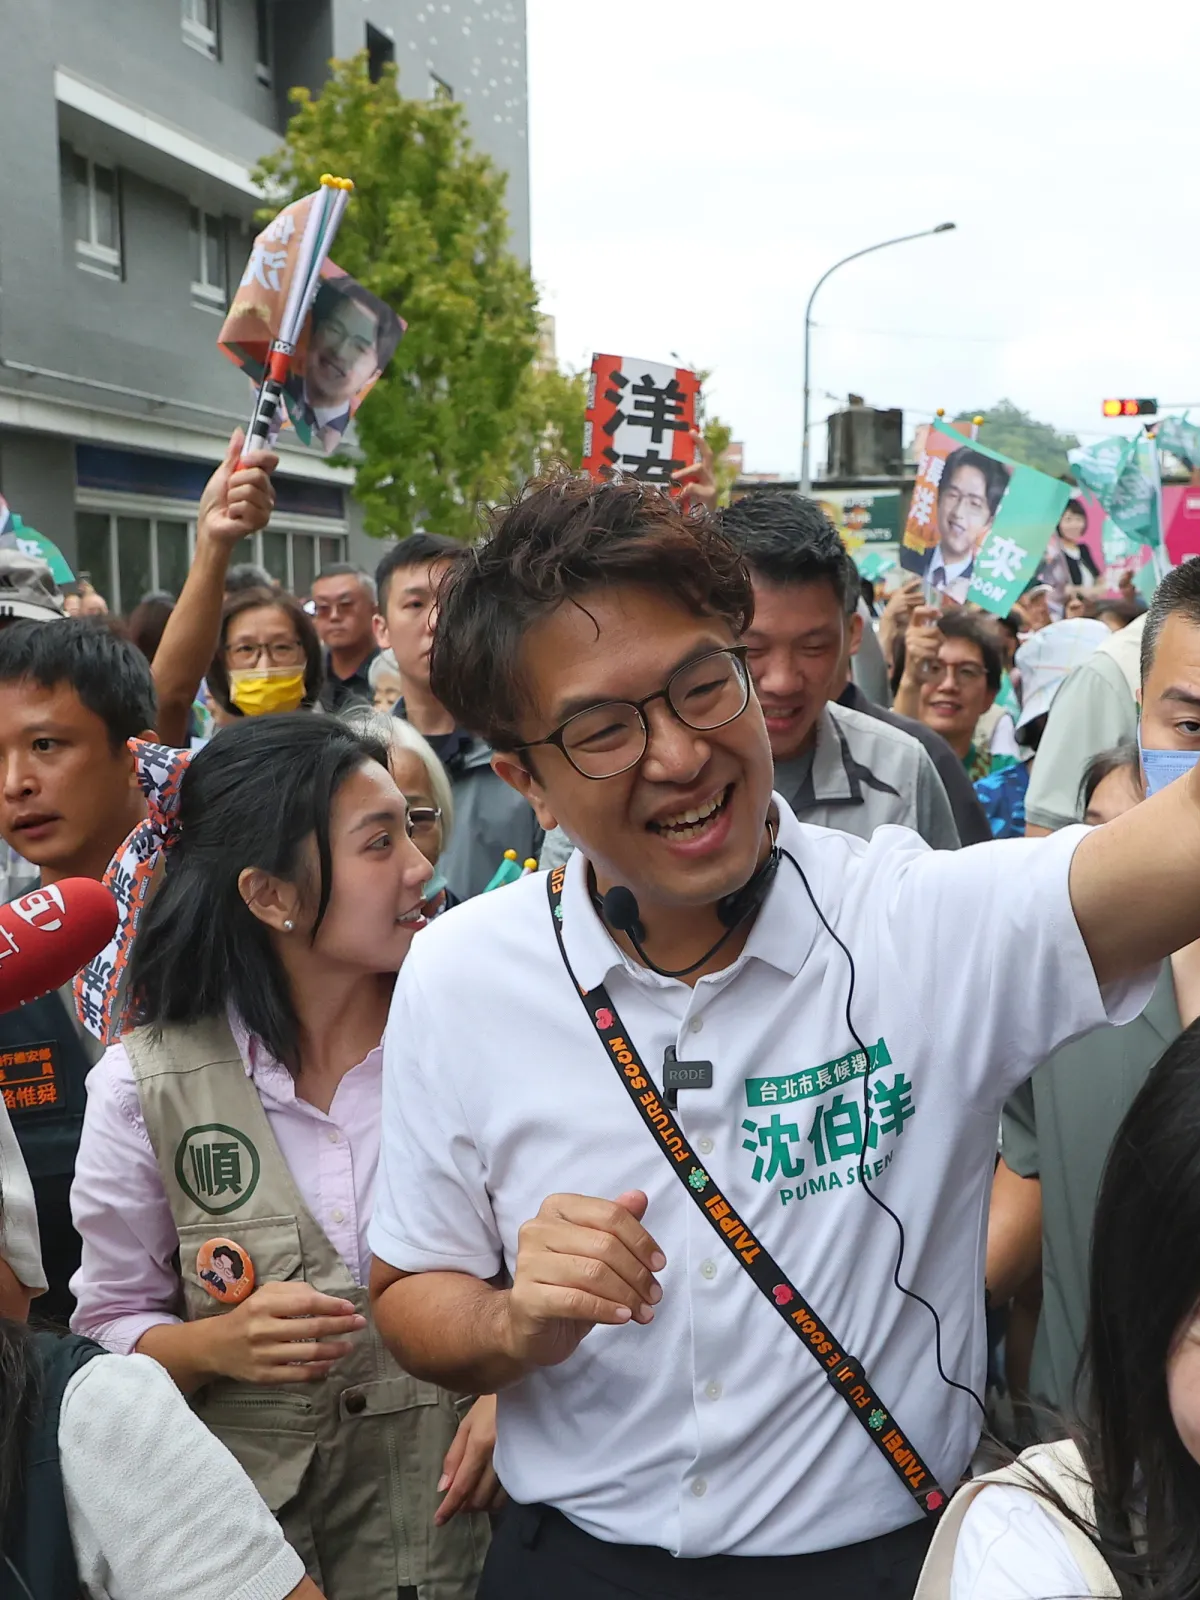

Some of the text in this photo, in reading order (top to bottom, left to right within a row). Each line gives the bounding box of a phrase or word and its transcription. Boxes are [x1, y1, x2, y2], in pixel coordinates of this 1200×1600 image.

[979, 535, 1028, 582] 來
[608, 1036, 690, 1163] FUTURE SOON
[669, 1069, 706, 1081] RØDE
[759, 1047, 880, 1103] 台北市長候選人
[741, 1073, 916, 1183] 沈伯洋
[189, 1142, 243, 1197] 順
[780, 1150, 894, 1206] PUMA SHEN
[704, 1194, 761, 1265] TAIPEI
[791, 1308, 833, 1354] SOON
[881, 1429, 926, 1489] TAIPEI
